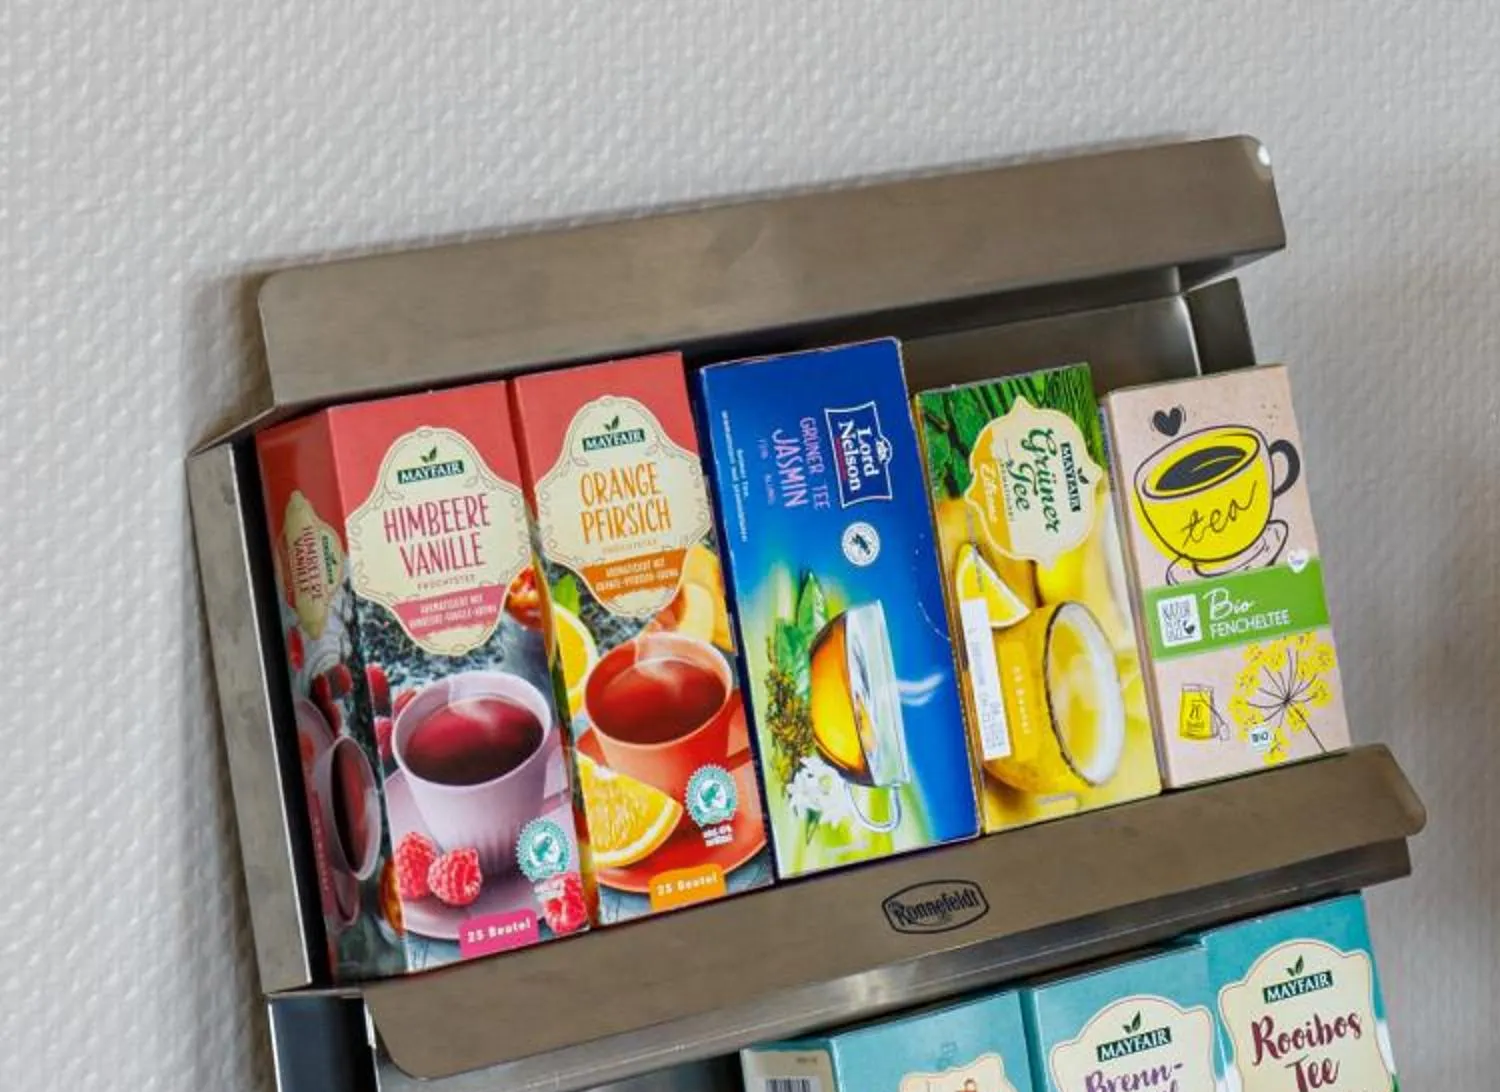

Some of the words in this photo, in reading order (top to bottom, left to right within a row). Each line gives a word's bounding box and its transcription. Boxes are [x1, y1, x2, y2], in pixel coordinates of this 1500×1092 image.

[583, 429, 645, 450] MAYFAIR
[838, 419, 862, 492] Nelson
[857, 426, 879, 477] Lord
[400, 461, 463, 483] MAYFAIR
[580, 462, 662, 505] ORANGE
[772, 429, 808, 509] JASMIN
[1007, 460, 1040, 513] Tee
[1021, 428, 1061, 534] Grüner
[1060, 441, 1081, 513] MAYFAIR
[383, 493, 491, 543] HIMBEERE
[813, 484, 831, 510] TEE
[1181, 480, 1258, 547] tea
[580, 499, 672, 544] PFIRSICH
[400, 532, 487, 577] VANILLE
[1203, 587, 1256, 620] Bio
[1209, 609, 1291, 639] FENCHELTEE
[887, 888, 981, 927] Ronnefeldt
[467, 930, 485, 944] 25
[488, 920, 531, 940] Beutel
[1264, 972, 1333, 1002] MAYFAIR
[1098, 1028, 1171, 1061] MAYFAIR
[1251, 1012, 1363, 1066] Rooibos
